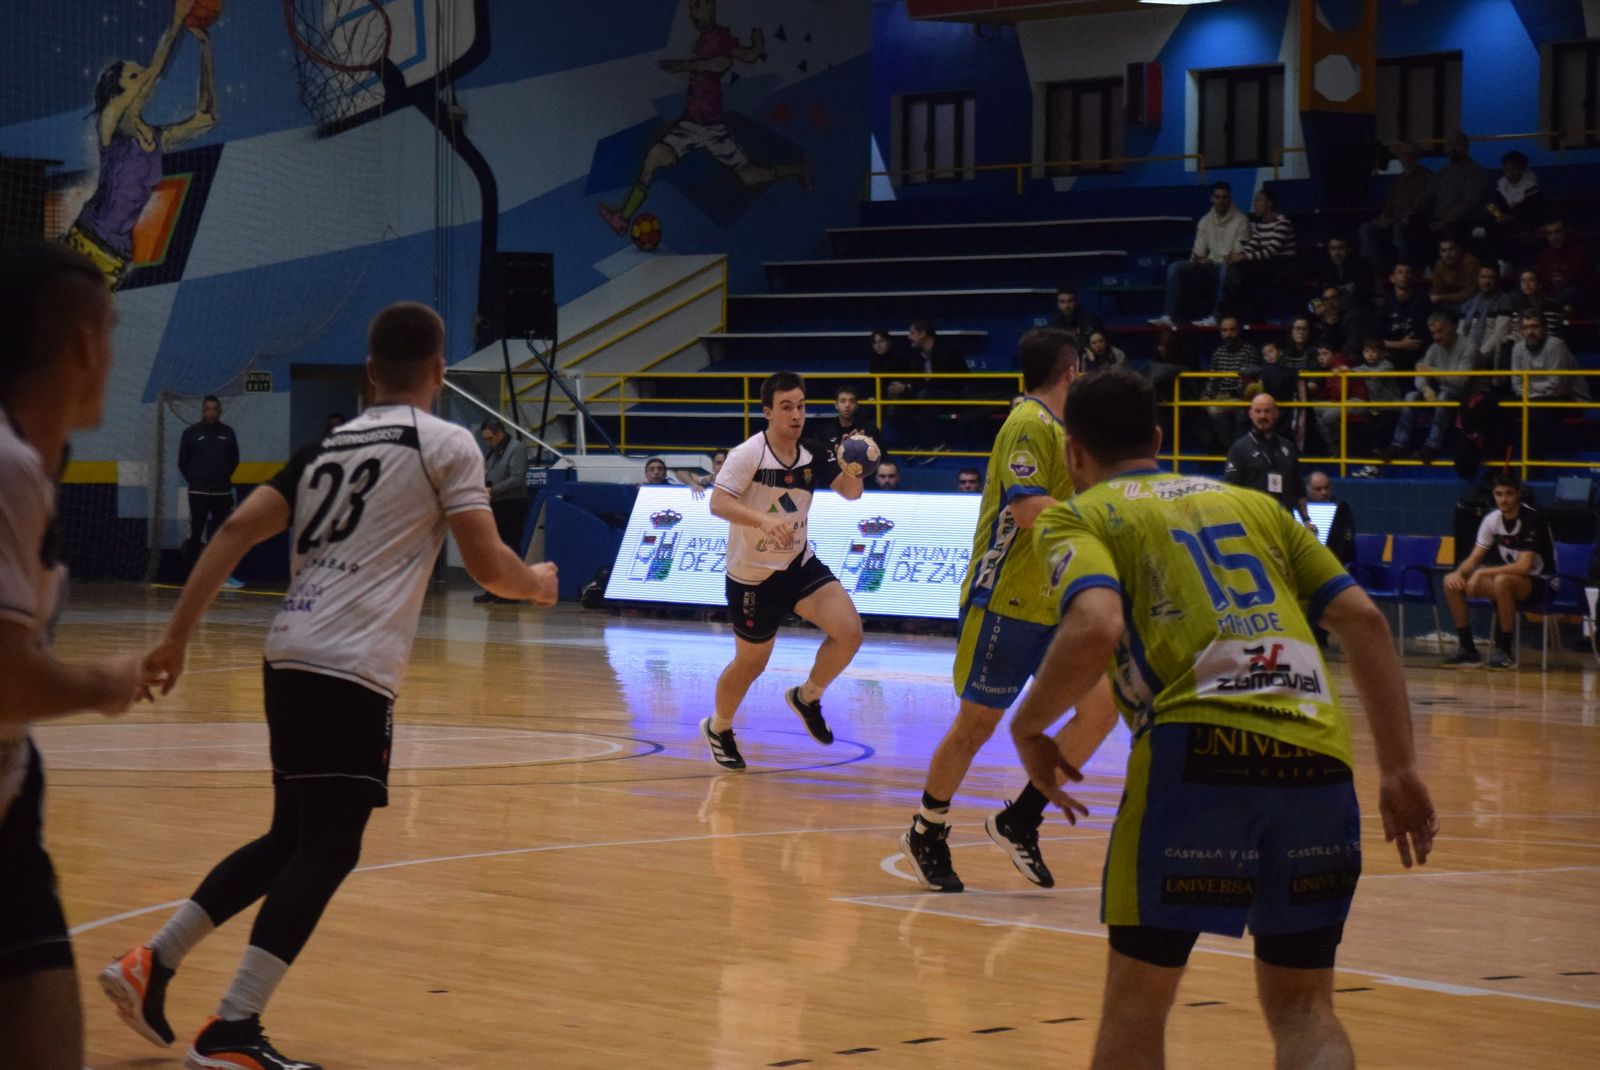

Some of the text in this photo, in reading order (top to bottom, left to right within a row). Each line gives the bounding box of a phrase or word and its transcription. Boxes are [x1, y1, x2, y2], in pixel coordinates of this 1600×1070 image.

[297, 457, 381, 554] 23
[1170, 522, 1275, 611] 15
[1216, 668, 1322, 695] zamovial
[1163, 848, 1223, 860] CASTILLA
[1228, 849, 1240, 861] Y
